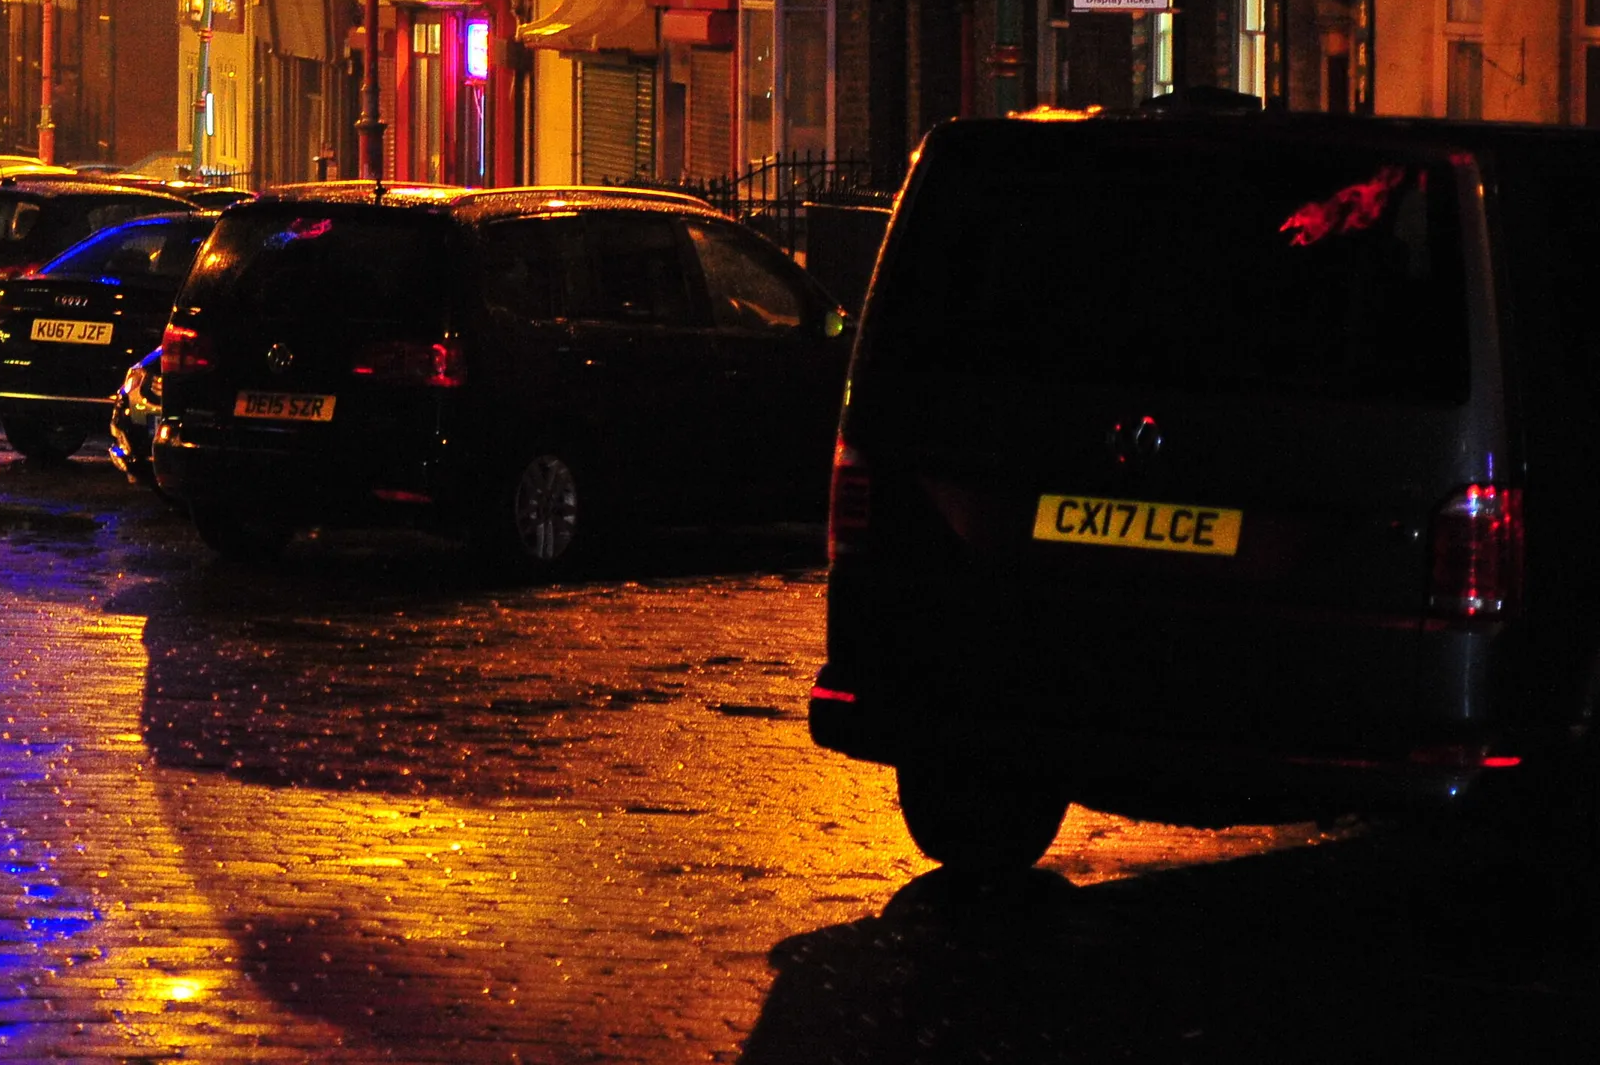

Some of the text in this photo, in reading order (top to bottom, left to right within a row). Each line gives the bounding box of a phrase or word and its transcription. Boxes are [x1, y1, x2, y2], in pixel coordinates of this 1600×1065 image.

[36, 322, 108, 341] KU67 JZF
[245, 394, 326, 417] DE15 SZR
[1055, 500, 1220, 547] CX17 LCE
